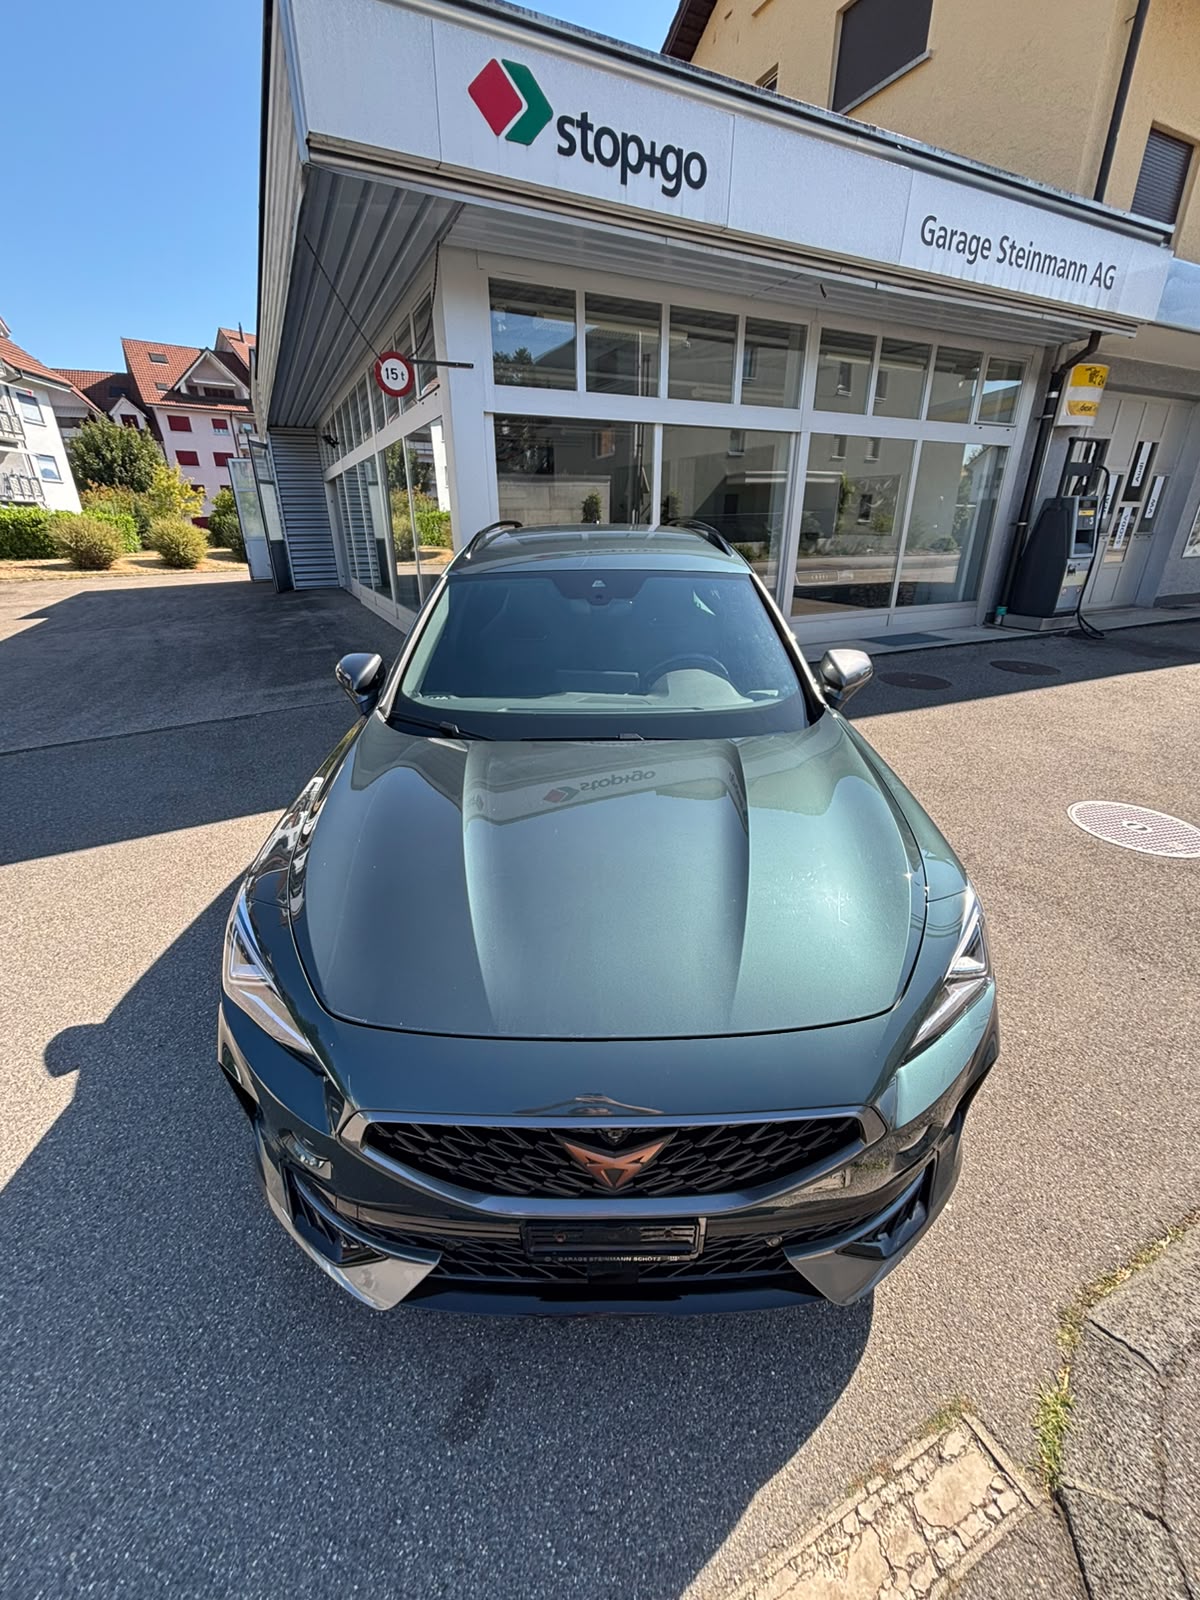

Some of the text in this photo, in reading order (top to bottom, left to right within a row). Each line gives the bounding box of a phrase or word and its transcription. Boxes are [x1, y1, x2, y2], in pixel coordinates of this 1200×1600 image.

[556, 112, 707, 198] stop+go
[920, 215, 1117, 290] Garage Steinmann AG
[385, 367, 405, 381] 15 t
[1147, 498, 1156, 514] VW
